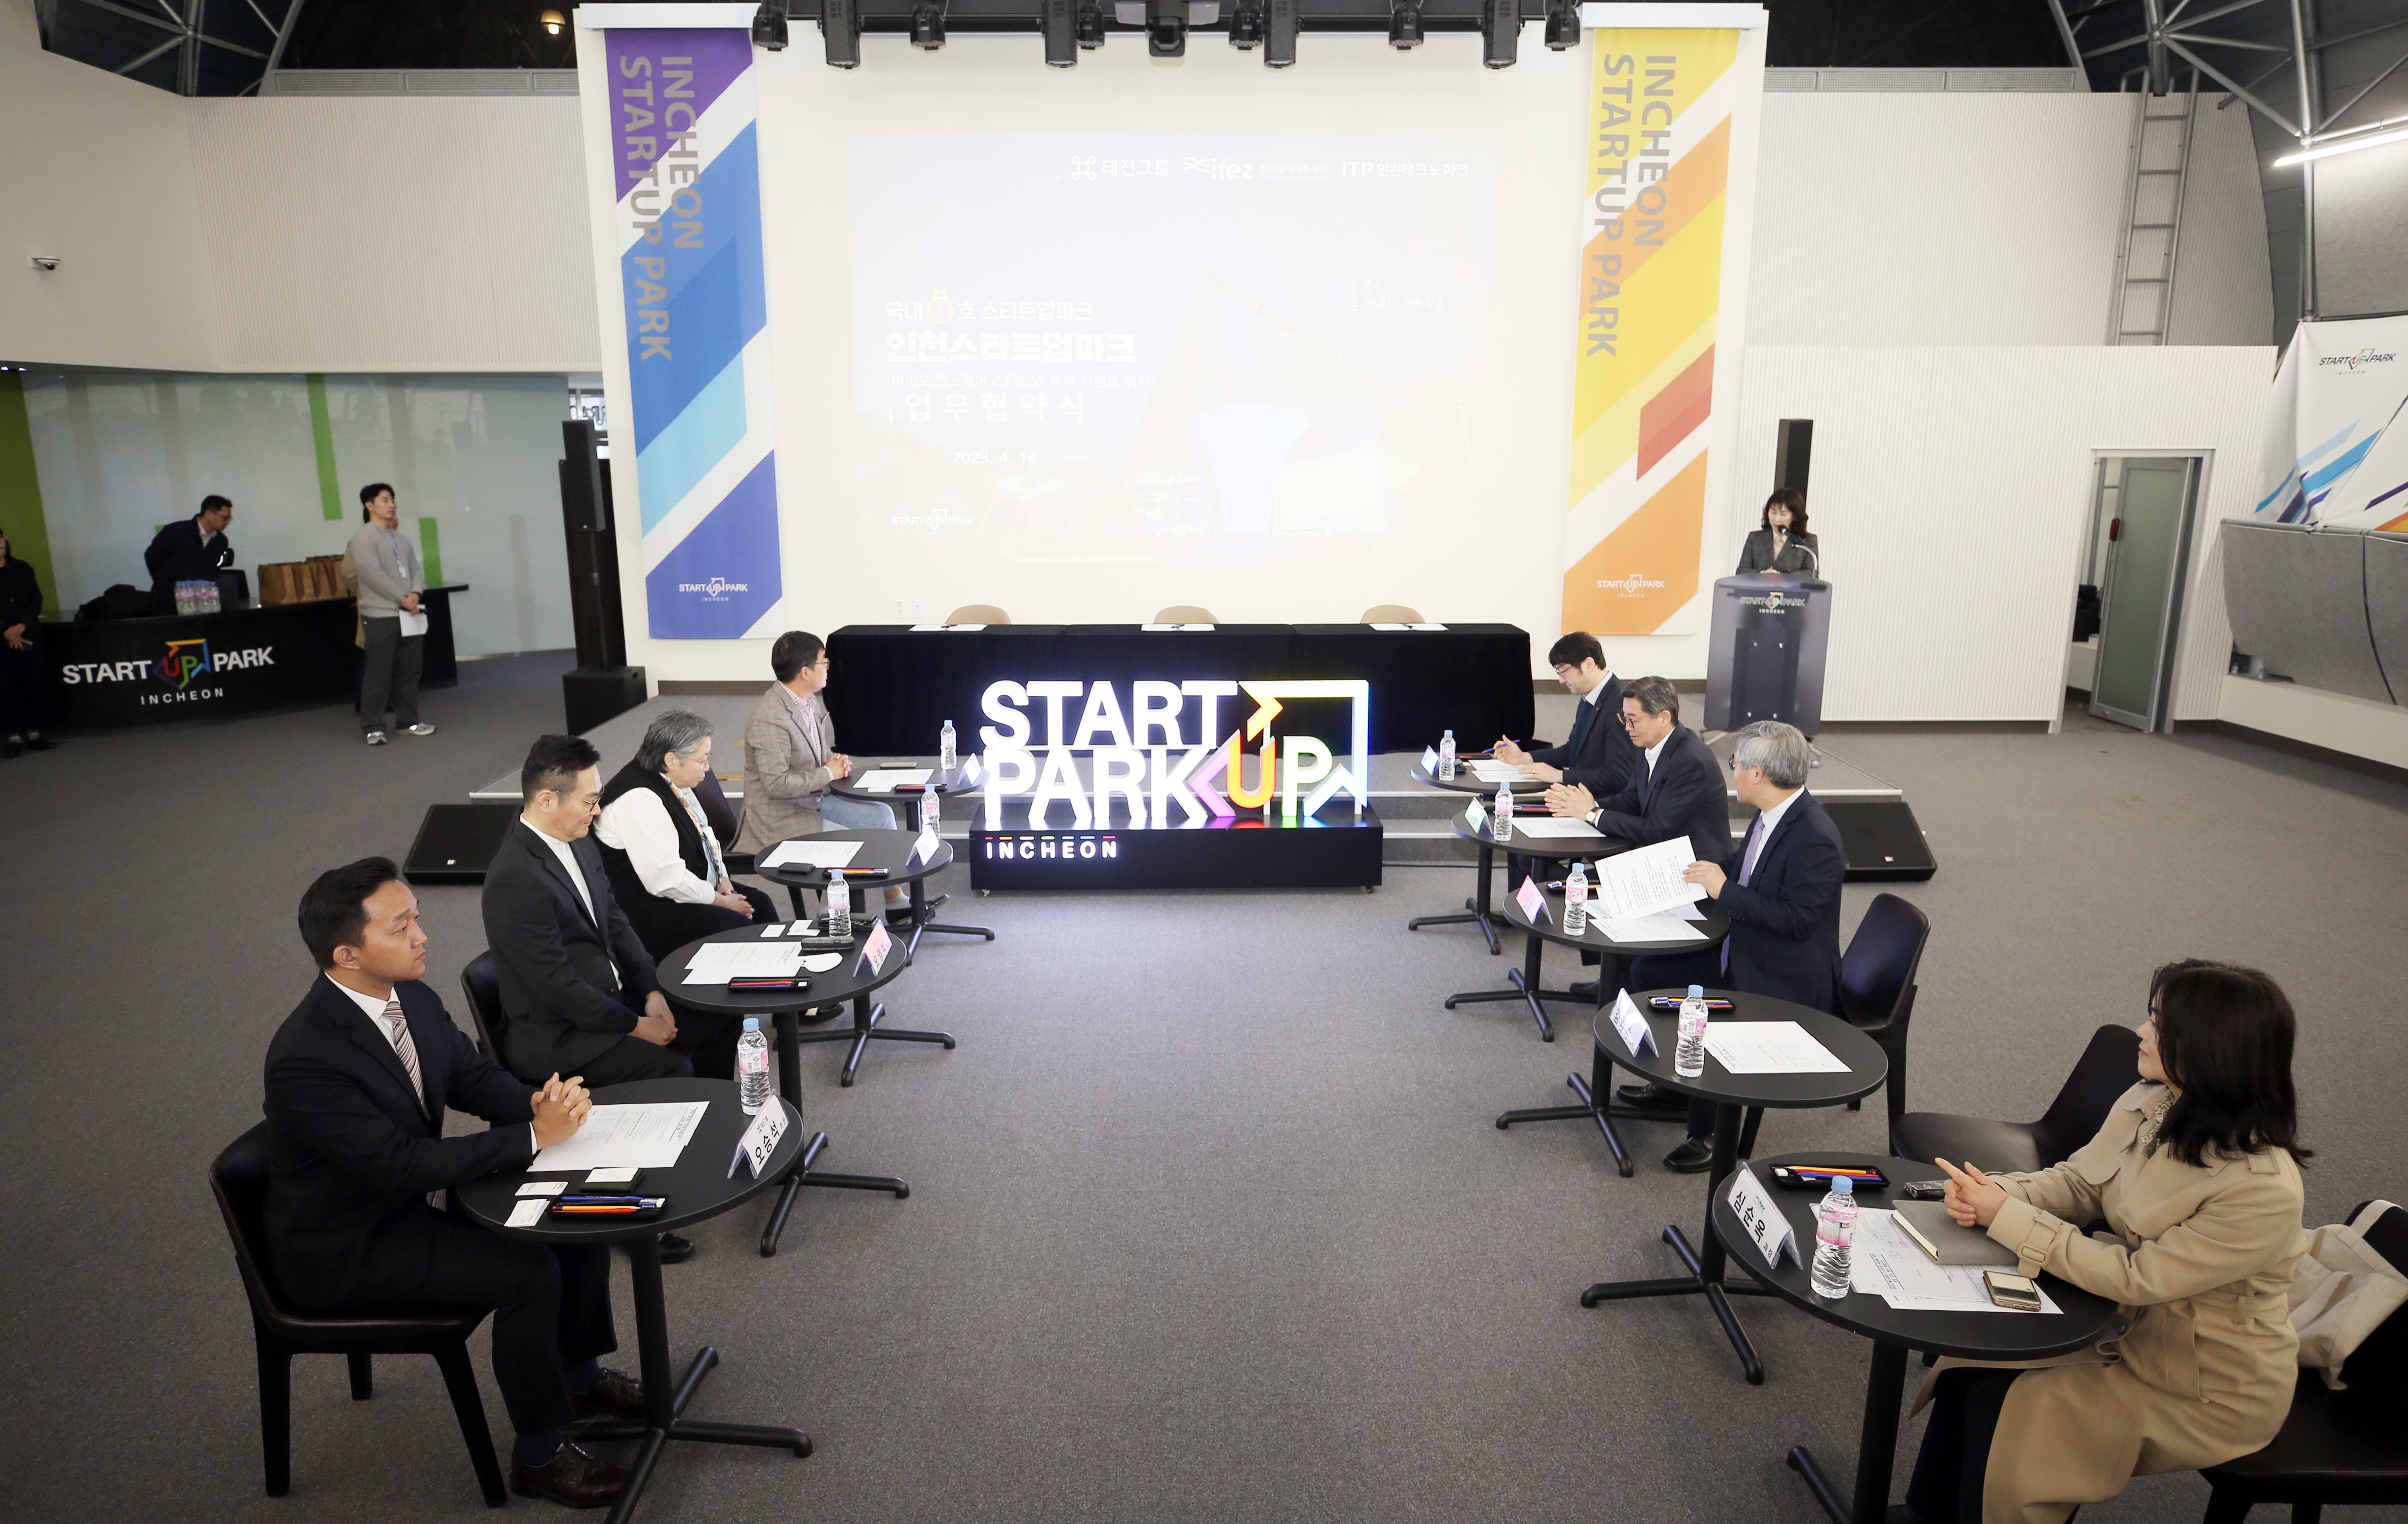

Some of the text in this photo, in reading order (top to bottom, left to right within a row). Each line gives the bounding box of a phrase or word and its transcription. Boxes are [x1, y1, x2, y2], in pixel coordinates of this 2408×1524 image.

[661, 56, 704, 249] INCHEON
[1634, 55, 1676, 246] INCHEON
[1102, 159, 1170, 177] 태전그룹
[1210, 158, 1254, 180] ifez
[1342, 161, 1373, 178] ITP
[1378, 161, 1469, 178] 인천테크노파크
[620, 55, 672, 361] STARTUP PARK
[1587, 54, 1635, 357] STARTUP PARK
[885, 301, 922, 321] 국내
[981, 302, 1093, 321] 스타트업파크
[886, 332, 1136, 363] 인천스타트업파크
[2319, 357, 2350, 365] START
[2369, 352, 2397, 363] PARK
[992, 374, 1044, 388] 스타트업
[1049, 374, 1075, 389] 육성
[1080, 374, 1120, 389] 지원을
[1124, 374, 1150, 389] 위한
[953, 452, 1041, 465] 2023. 4. 14.
[892, 516, 925, 525] START
[949, 516, 976, 525] PARK
[679, 584, 706, 592] START
[726, 583, 748, 592] PARK
[1596, 580, 1624, 588] START
[1643, 580, 1665, 588] PARK
[1739, 596, 1766, 605] START
[1783, 598, 1806, 607] PARK
[62, 660, 152, 685] START
[213, 647, 275, 673] PARK
[140, 688, 224, 705] INCHEON
[979, 680, 1238, 750] START
[983, 748, 1209, 819] PARK
[986, 840, 1118, 859] INCHEON
[755, 1120, 779, 1165] 오승석
[1734, 1191, 1765, 1243] 심순옥
